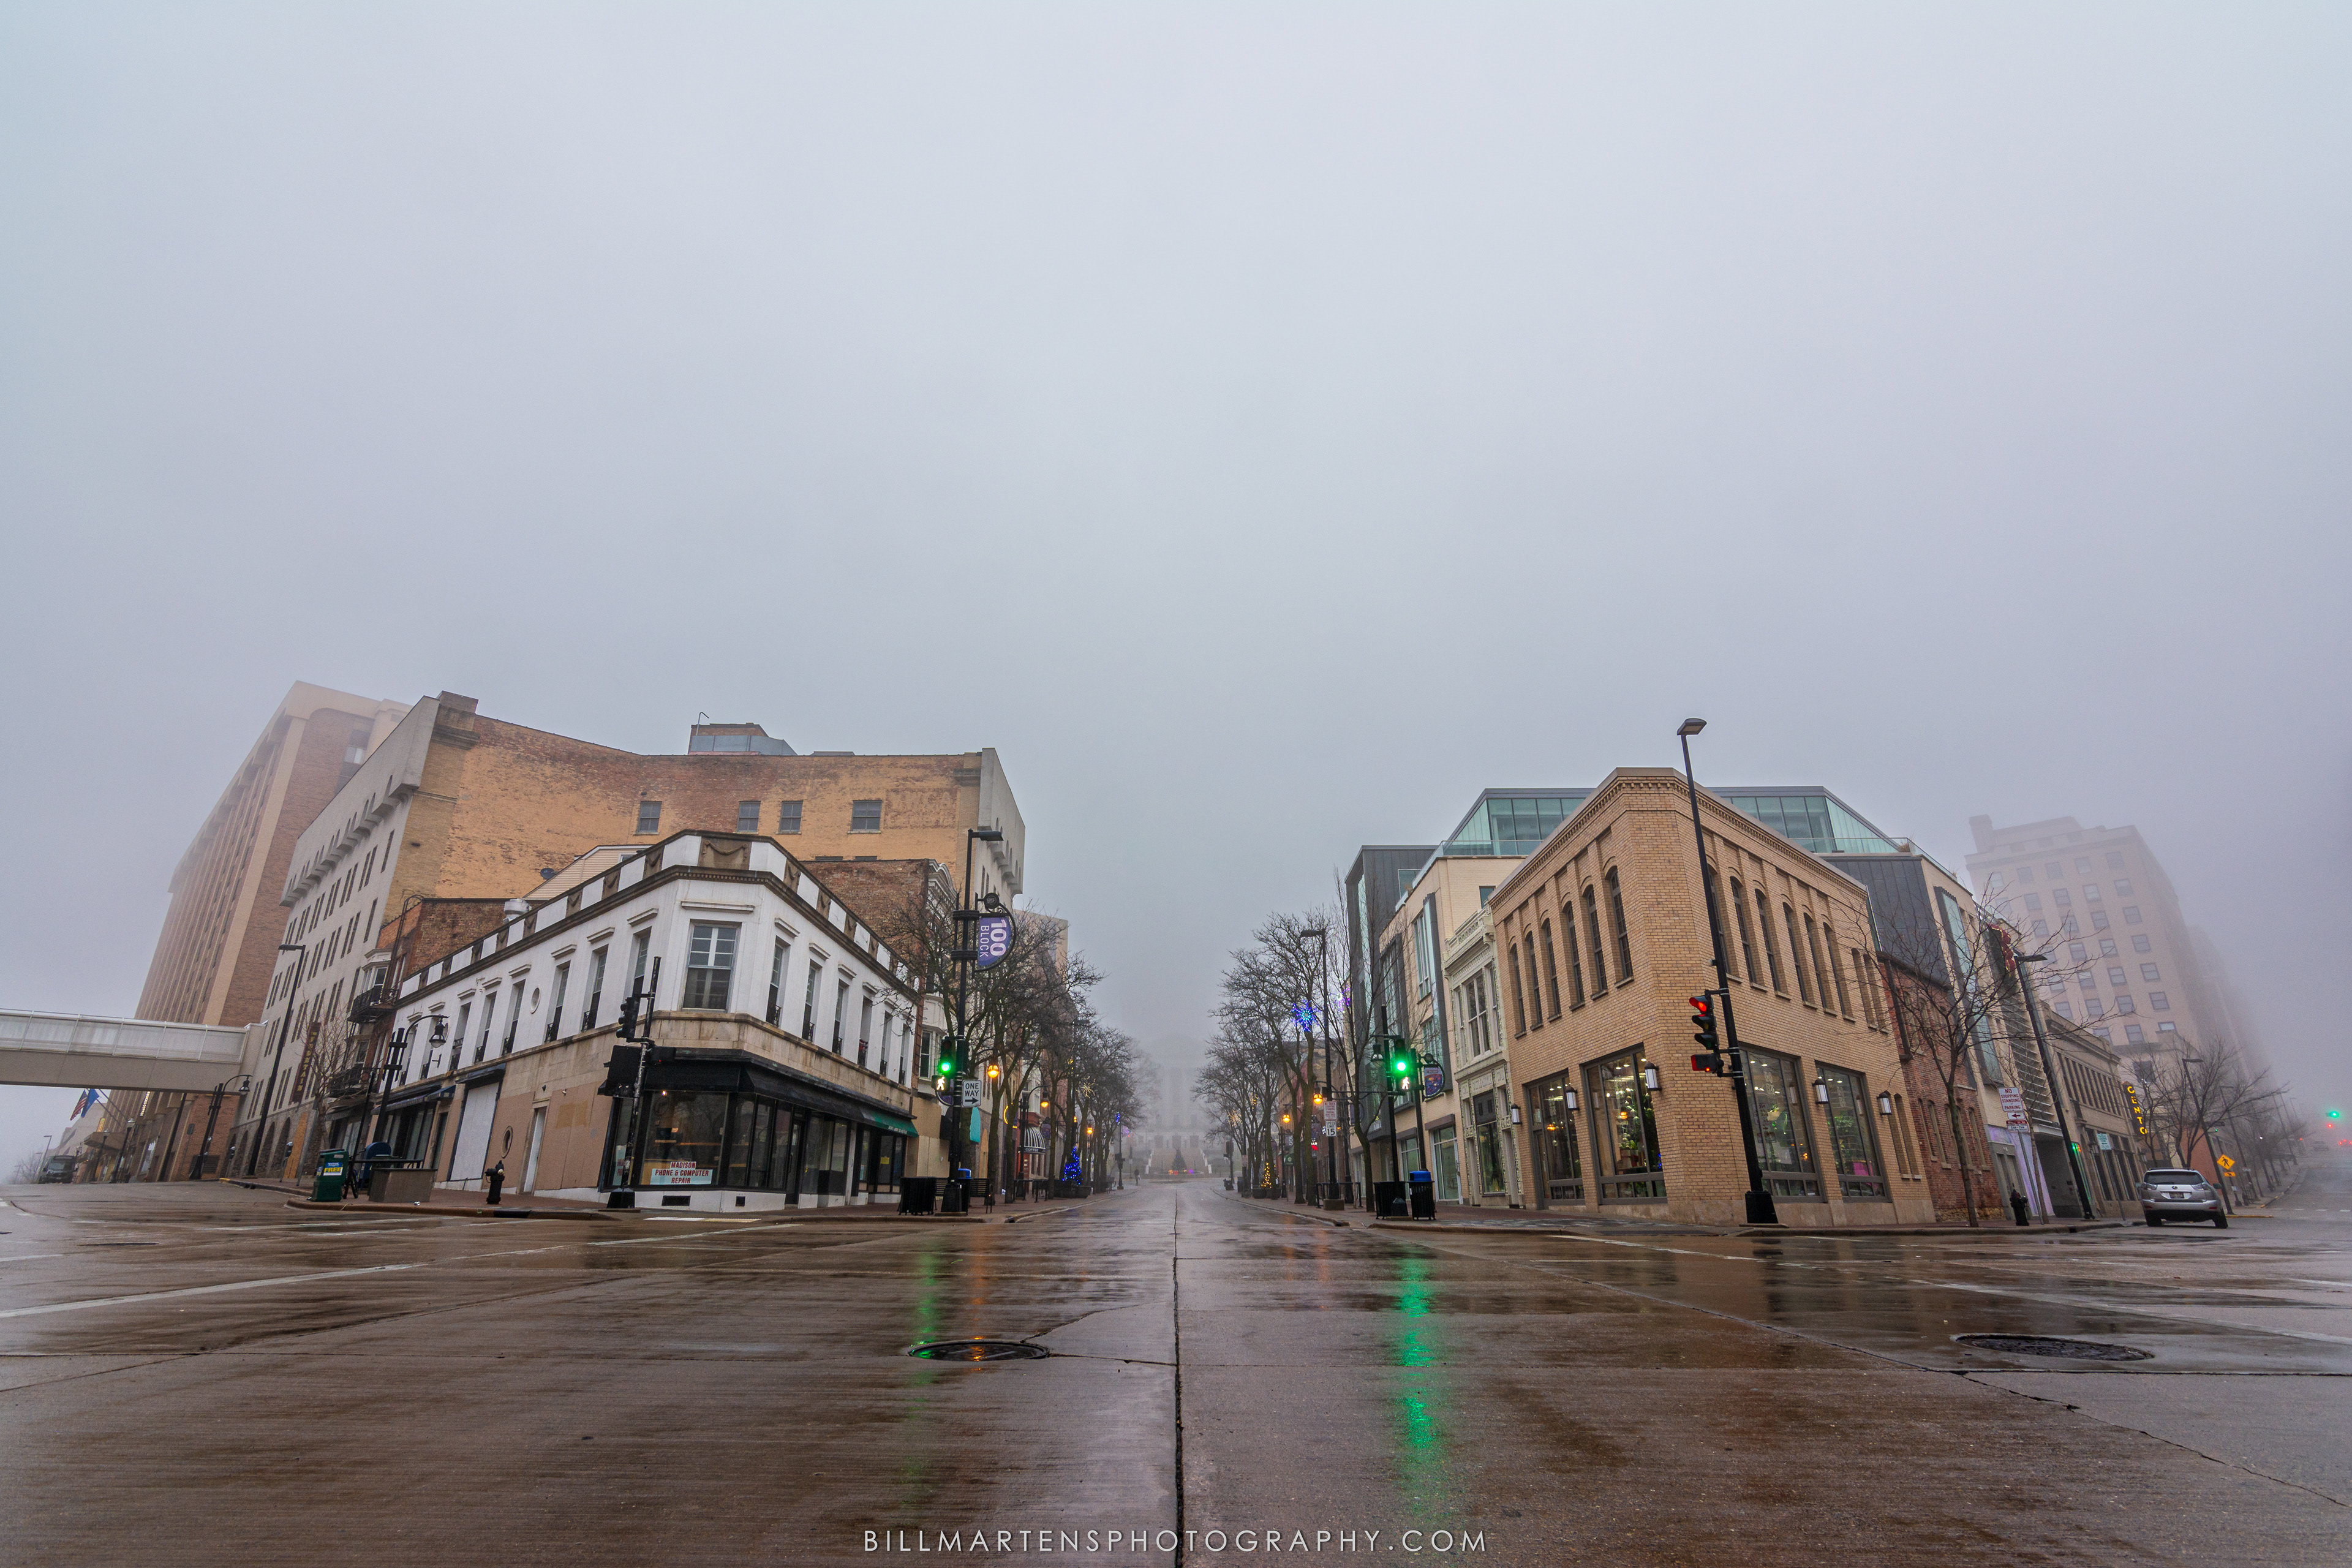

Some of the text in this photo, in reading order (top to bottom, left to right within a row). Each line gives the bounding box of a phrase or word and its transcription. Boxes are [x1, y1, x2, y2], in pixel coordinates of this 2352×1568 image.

[979, 925, 990, 957] BLOCK
[990, 919, 1007, 956] 100
[296, 1036, 315, 1091] FOUNTAIN
[2127, 1086, 2147, 1135] CENTO
